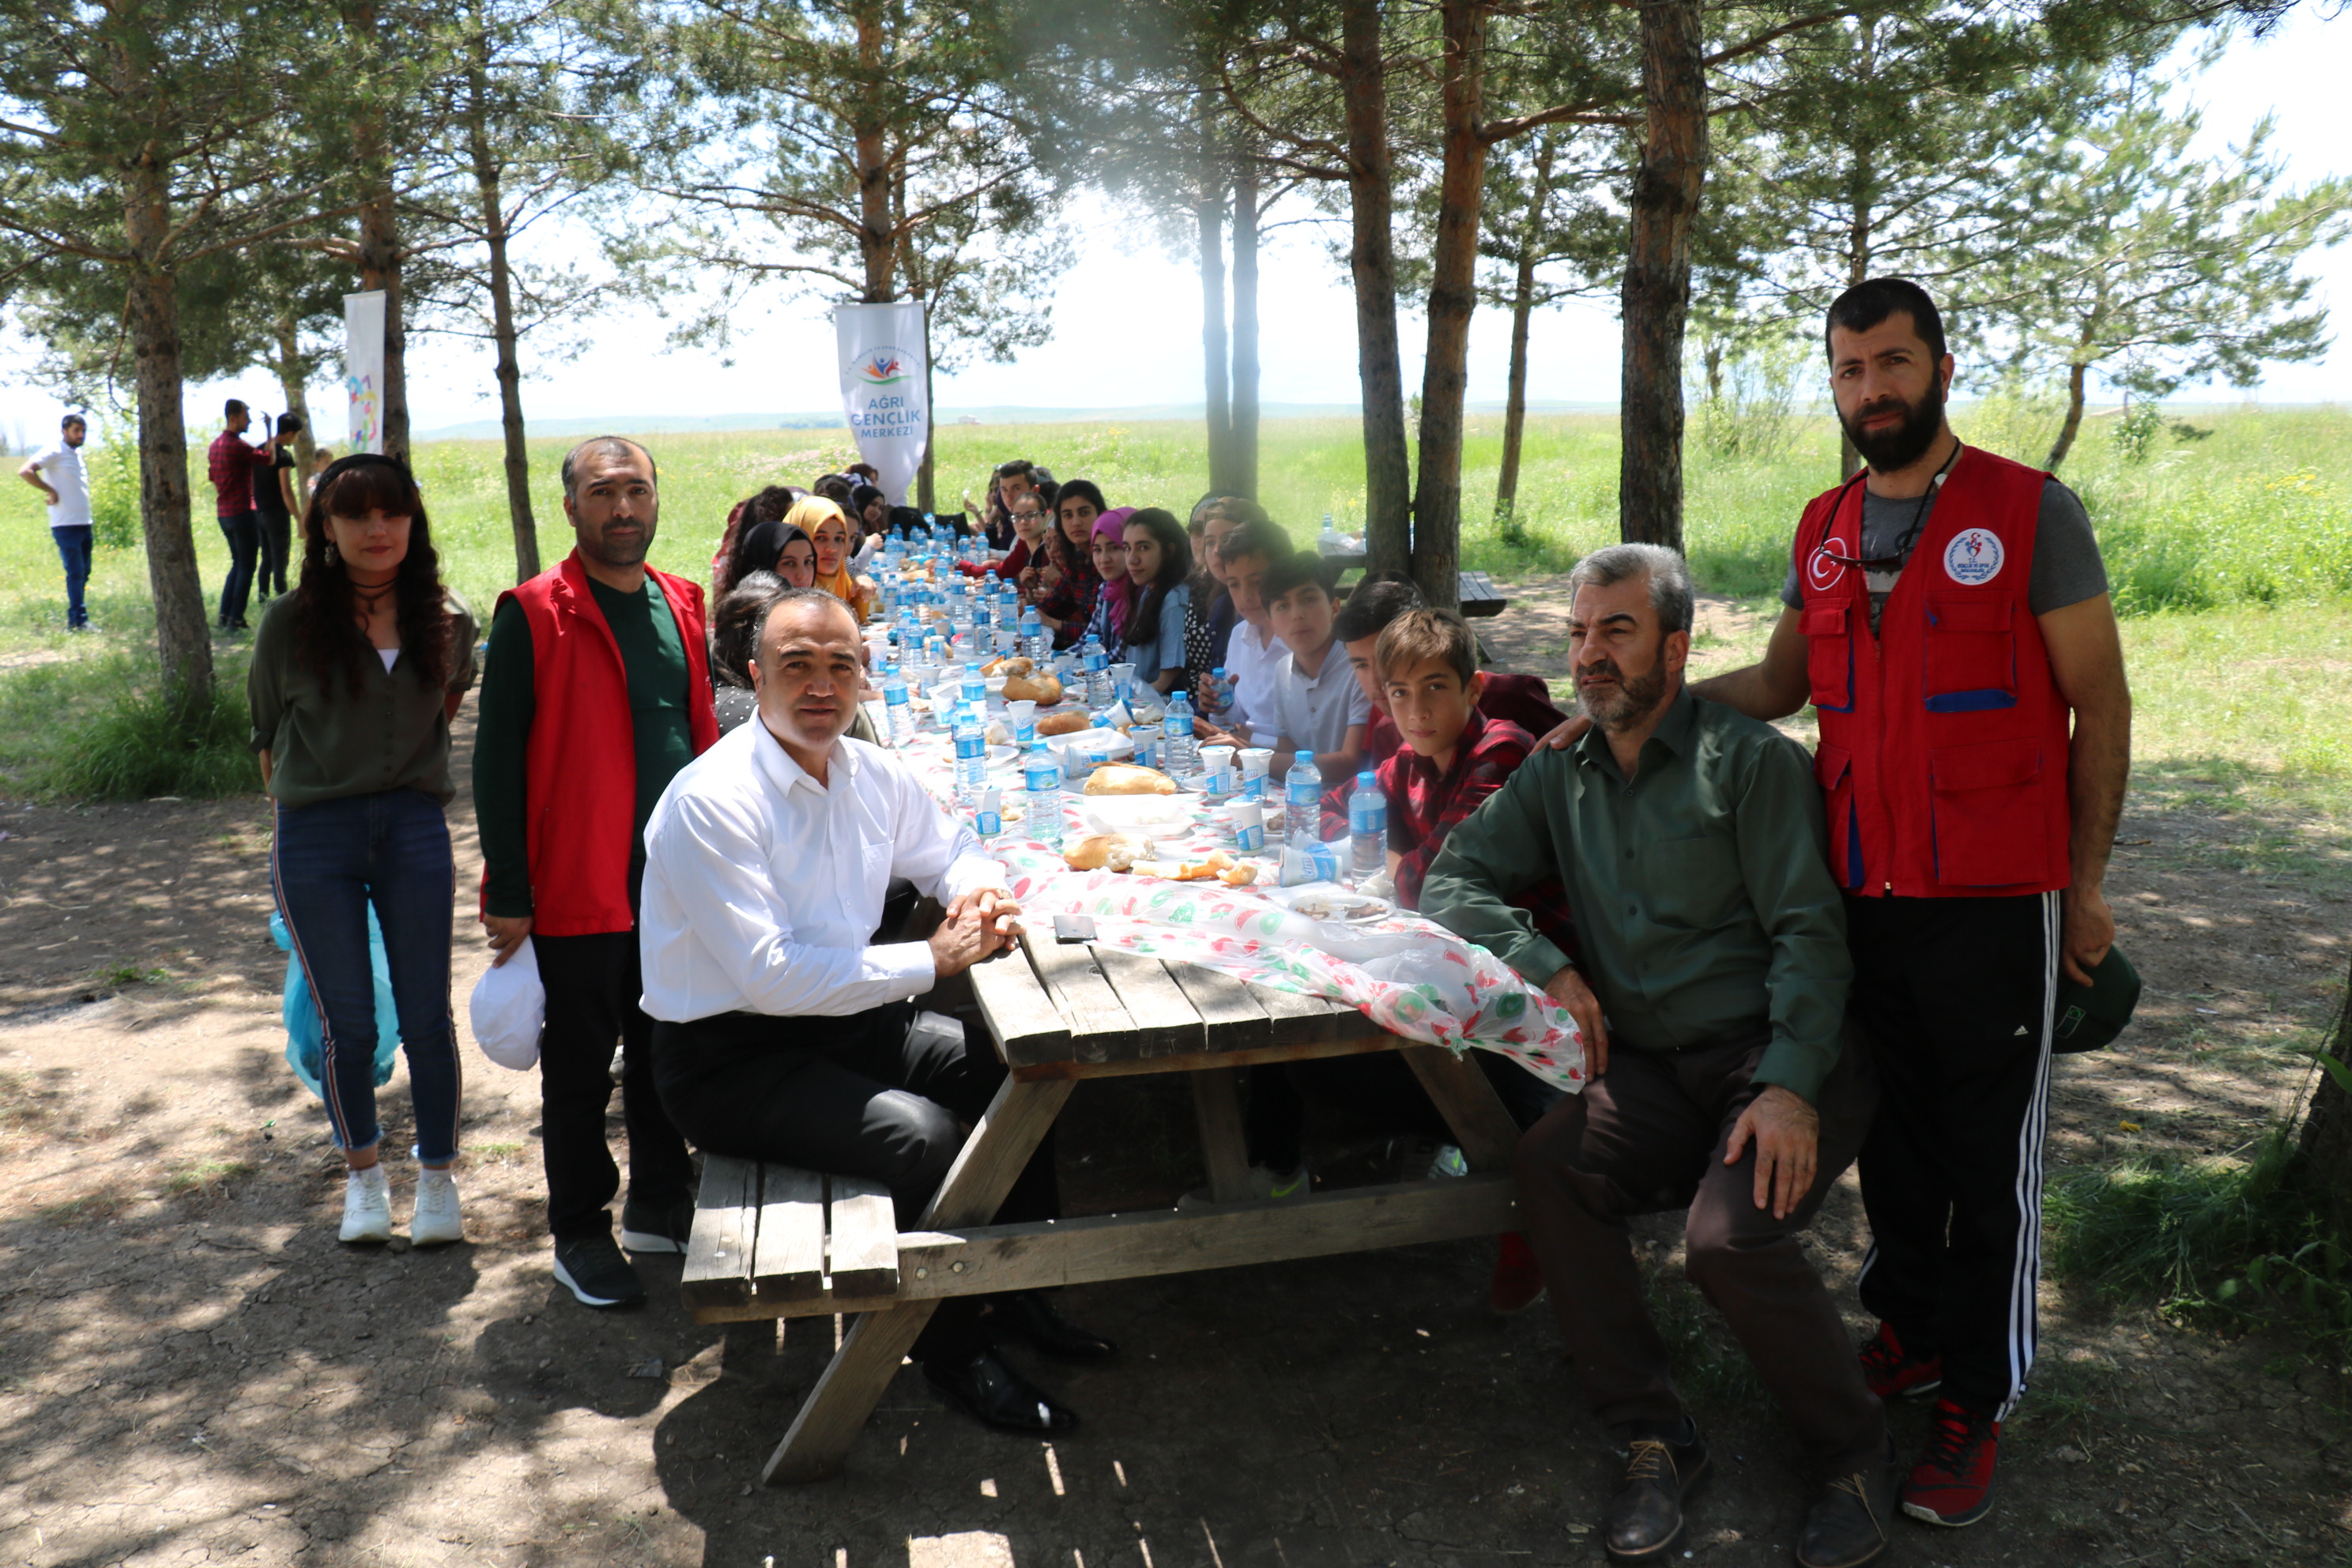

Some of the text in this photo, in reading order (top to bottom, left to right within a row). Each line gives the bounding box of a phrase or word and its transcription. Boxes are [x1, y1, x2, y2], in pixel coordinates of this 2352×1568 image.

[869, 395, 904, 410] AĞRI
[851, 409, 921, 426] GENÇLİK
[861, 425, 914, 439] MERKEZİ
